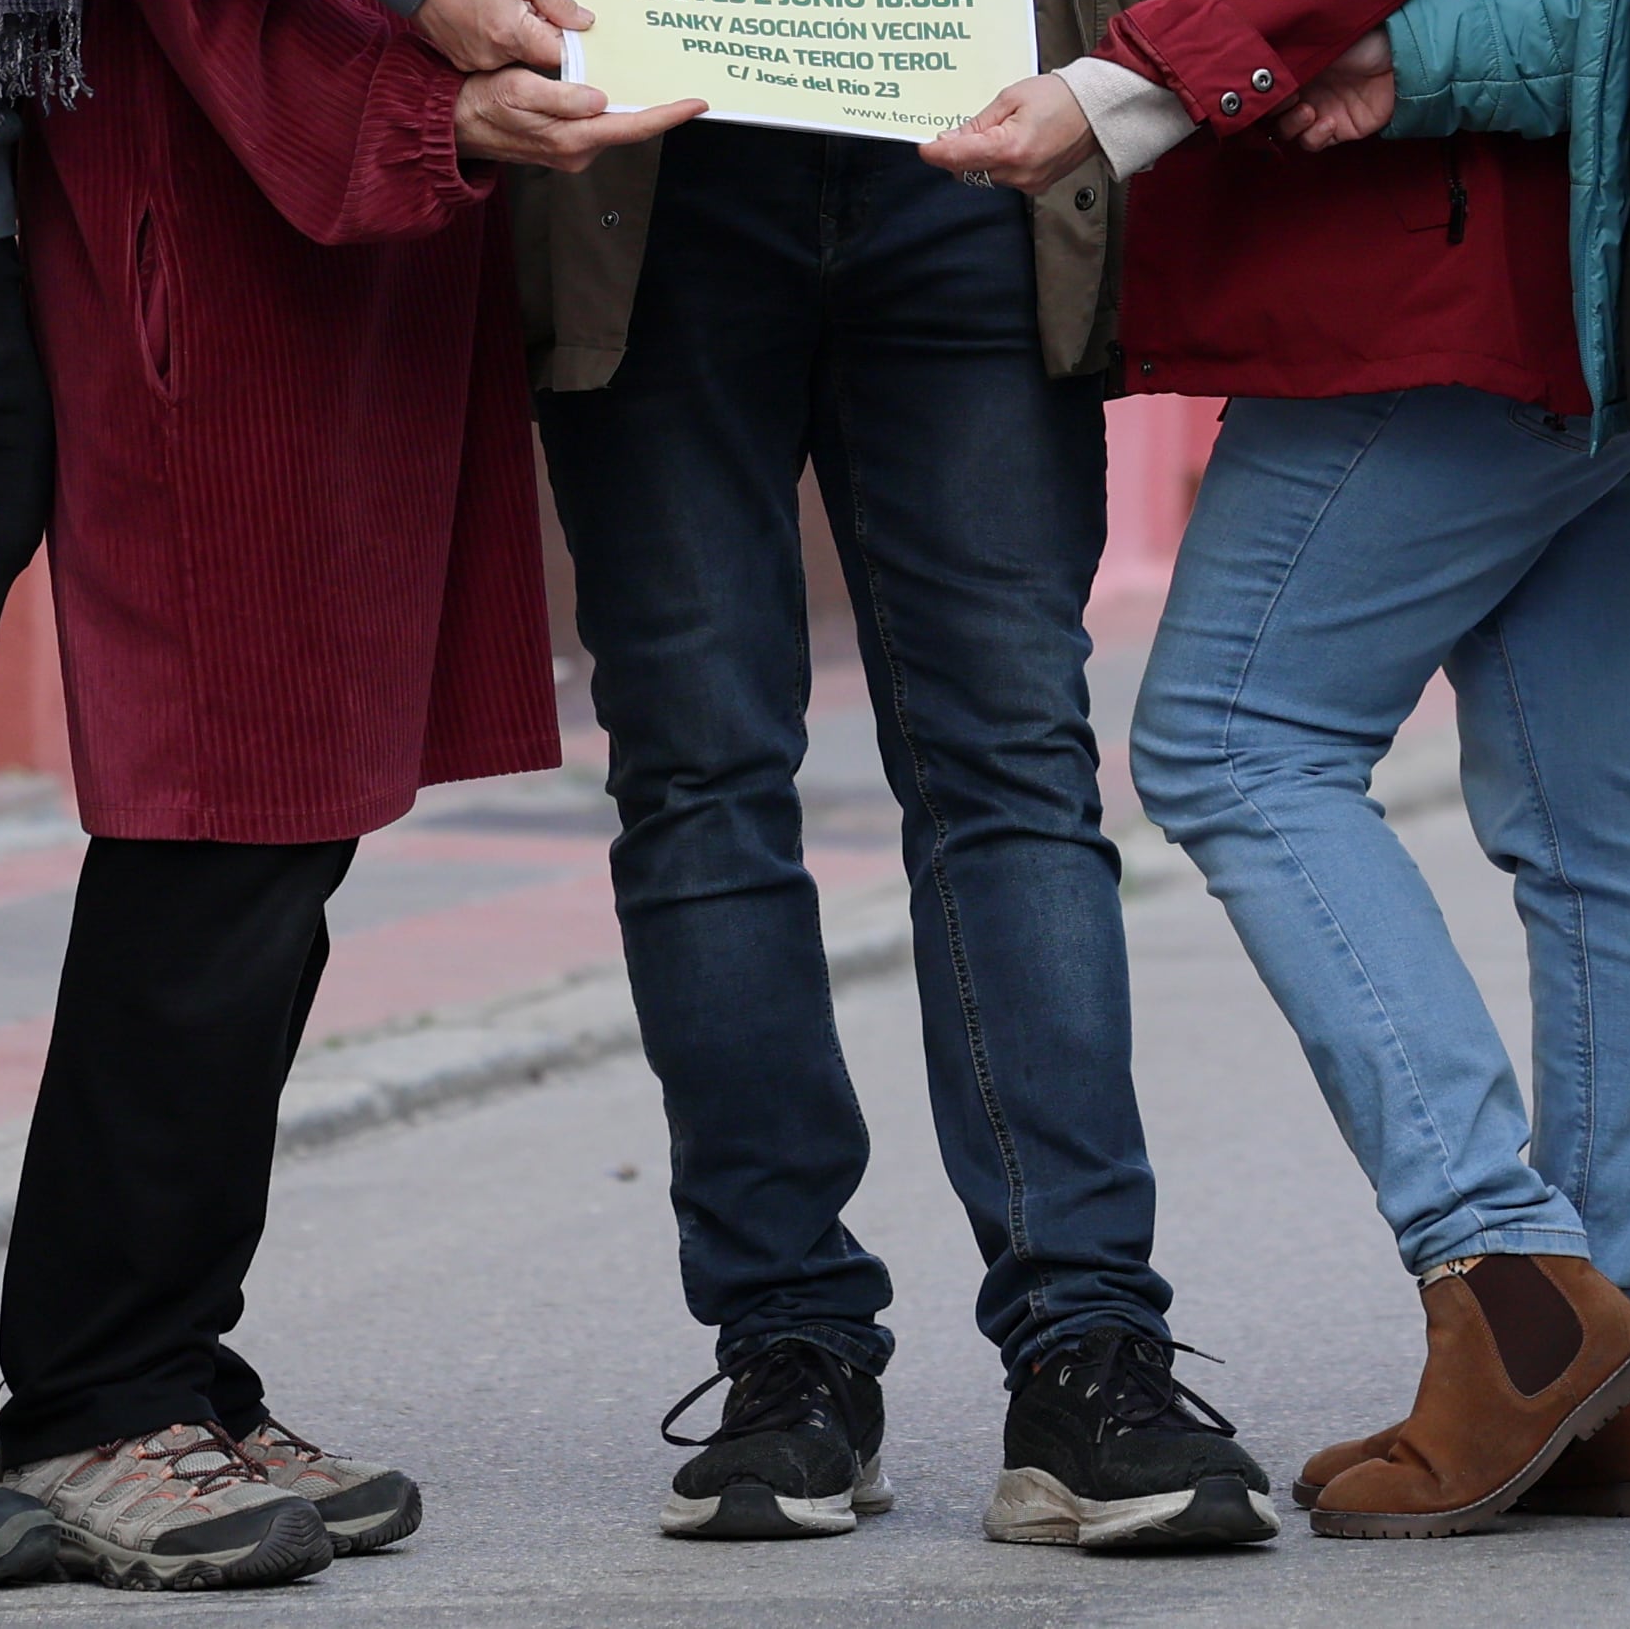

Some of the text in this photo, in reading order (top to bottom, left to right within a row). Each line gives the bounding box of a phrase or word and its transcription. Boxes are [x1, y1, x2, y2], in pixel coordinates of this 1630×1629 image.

[645, 10, 971, 40] SANKY ASOCIACIÓN VECINAL
[682, 37, 957, 70] PRADERA TERCIO TEROL
[727, 64, 900, 99] C/ José del Río 23
